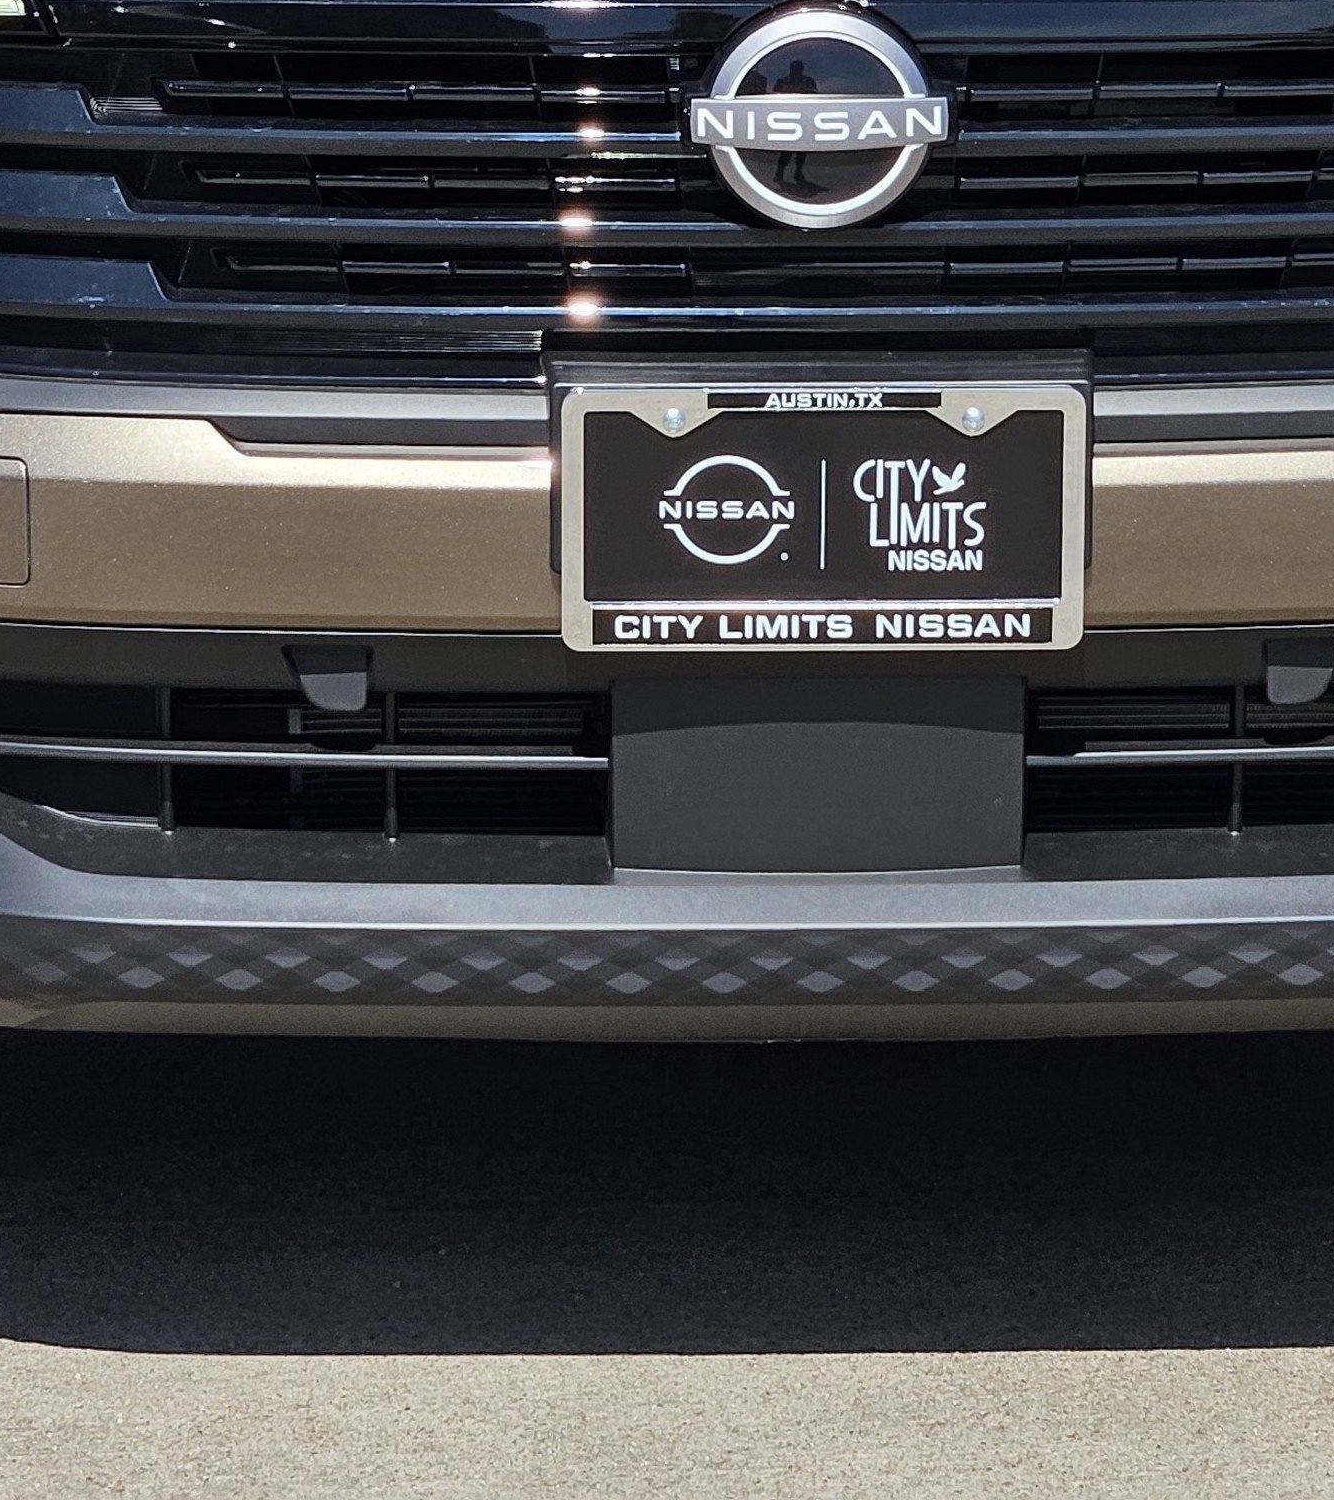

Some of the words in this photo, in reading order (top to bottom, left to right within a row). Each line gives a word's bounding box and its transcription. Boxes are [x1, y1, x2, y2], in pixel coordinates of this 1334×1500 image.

[696, 105, 943, 142] NISSAN
[853, 458, 931, 502] CITY
[658, 500, 795, 520] NISSAN
[869, 501, 987, 548] LIMITS
[887, 549, 983, 572] NISSAN
[613, 613, 704, 640] CITY
[719, 613, 853, 640] LIMITS
[875, 613, 1031, 639] NISSAN
